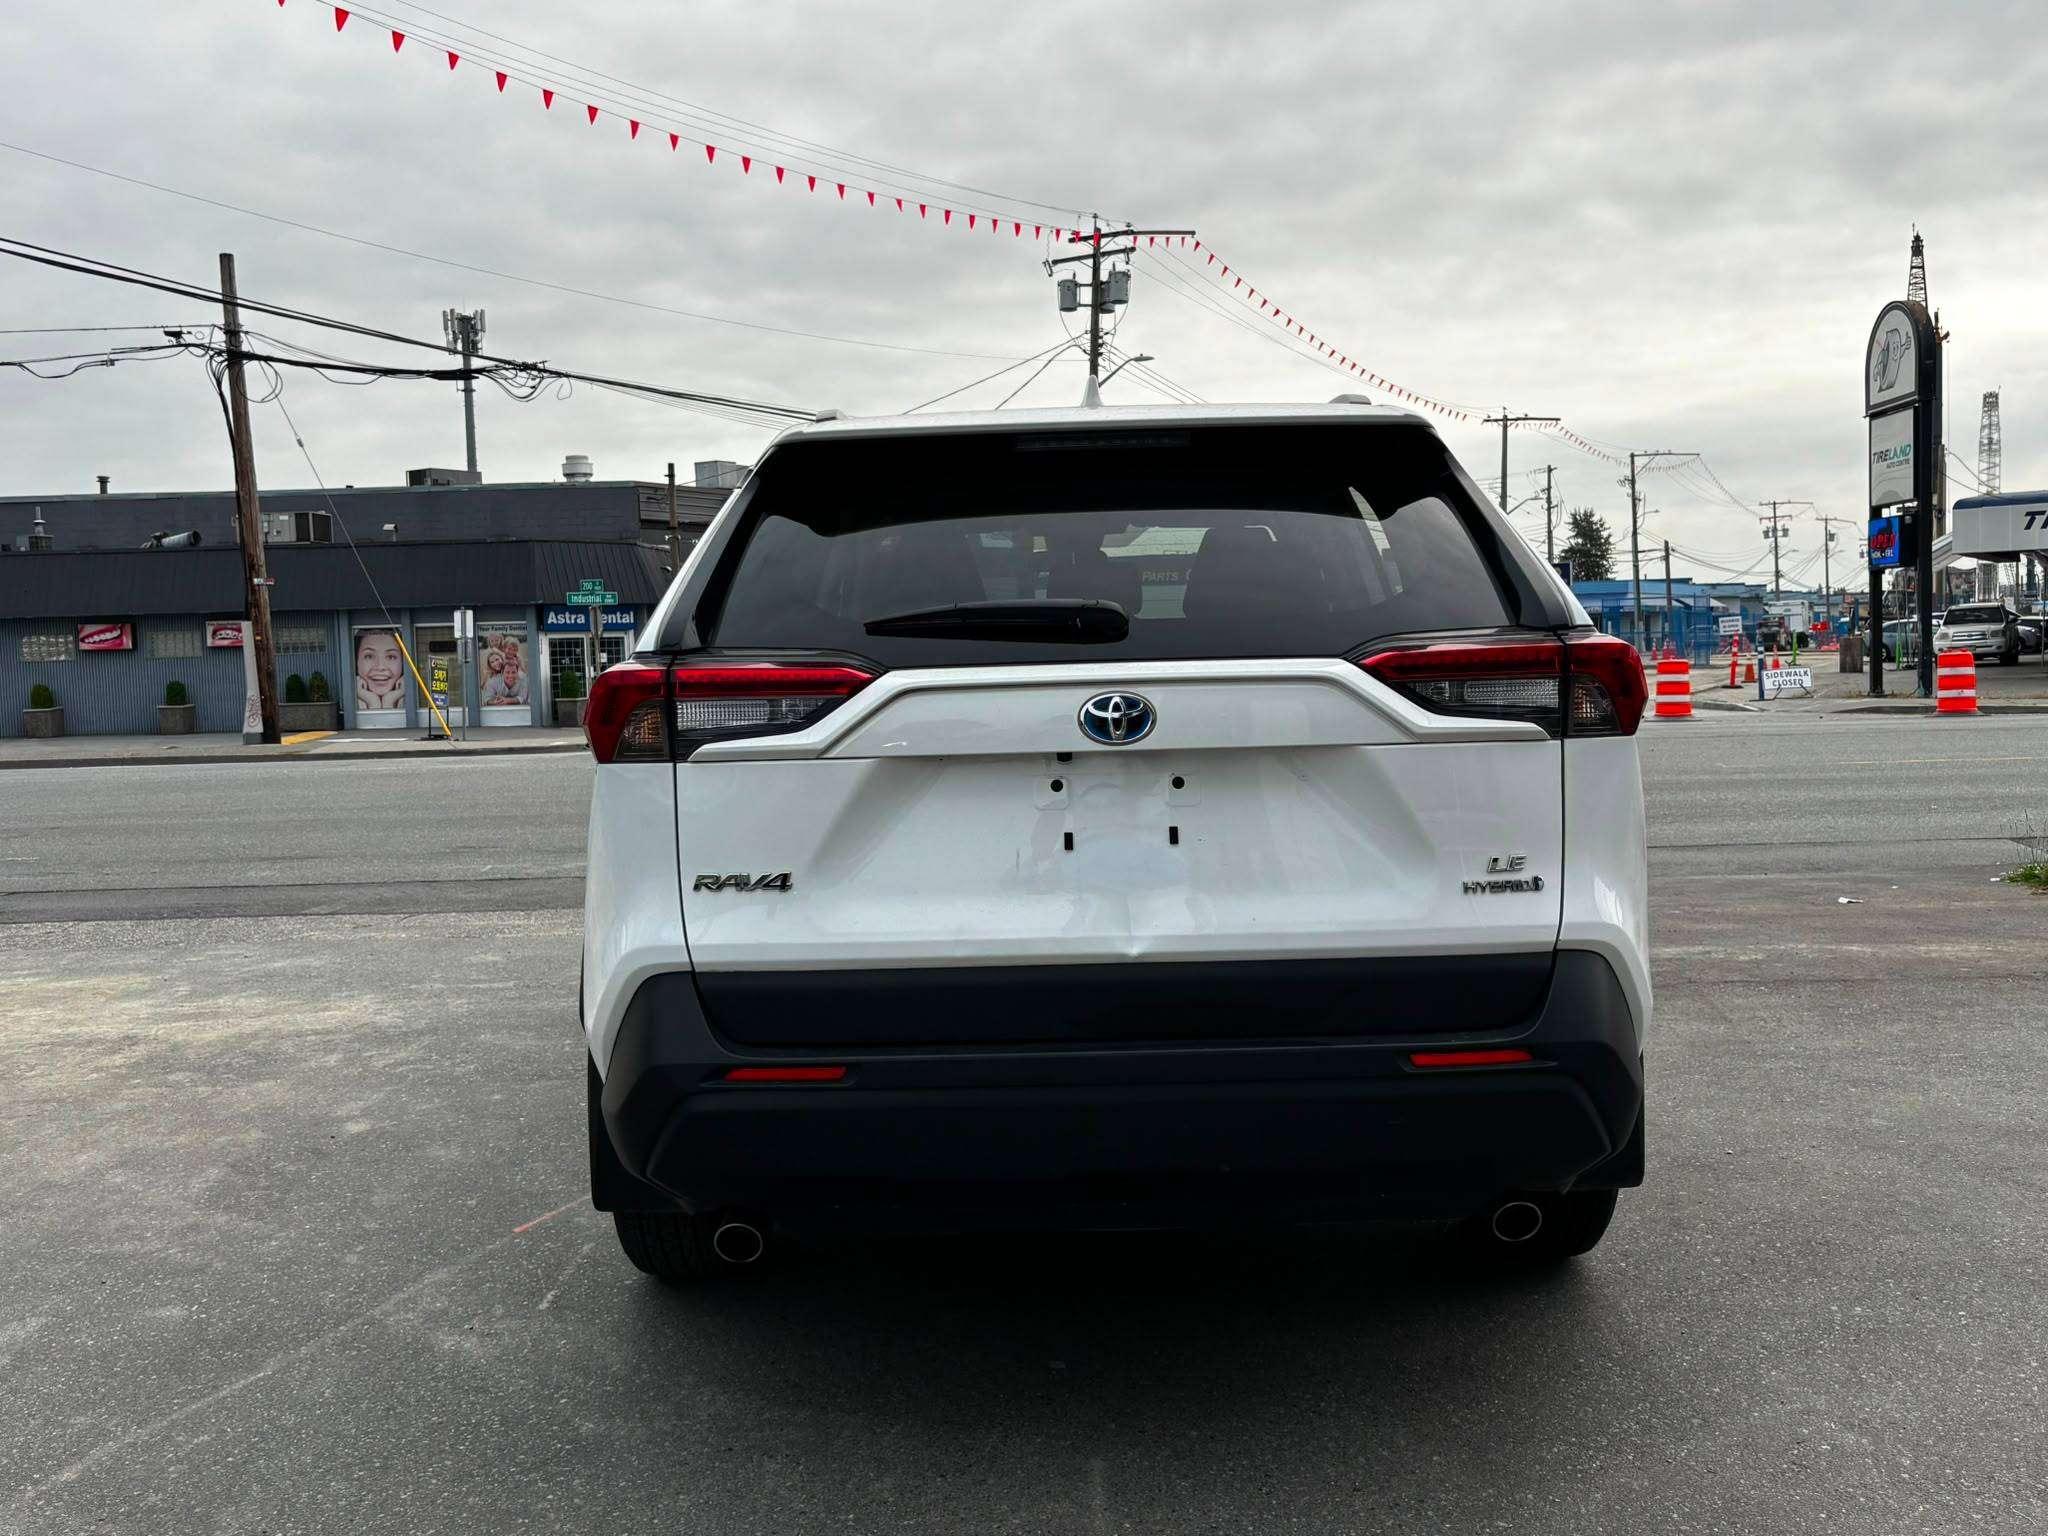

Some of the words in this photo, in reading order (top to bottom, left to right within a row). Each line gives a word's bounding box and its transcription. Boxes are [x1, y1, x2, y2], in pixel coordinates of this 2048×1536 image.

[1872, 444, 1912, 465] TIRELAND
[1870, 533, 1896, 549] OPEN
[1142, 571, 1179, 581] PARTS
[582, 582, 593, 591] 200
[571, 594, 602, 603] Industrial
[547, 611, 586, 624] Astra
[601, 611, 634, 624] ental
[1764, 669, 1810, 680] SIDEWALK
[1772, 678, 1804, 688] CLOSED
[1487, 854, 1527, 873] LE
[693, 871, 793, 892] RAV4
[1462, 878, 1532, 894] HYBRID
